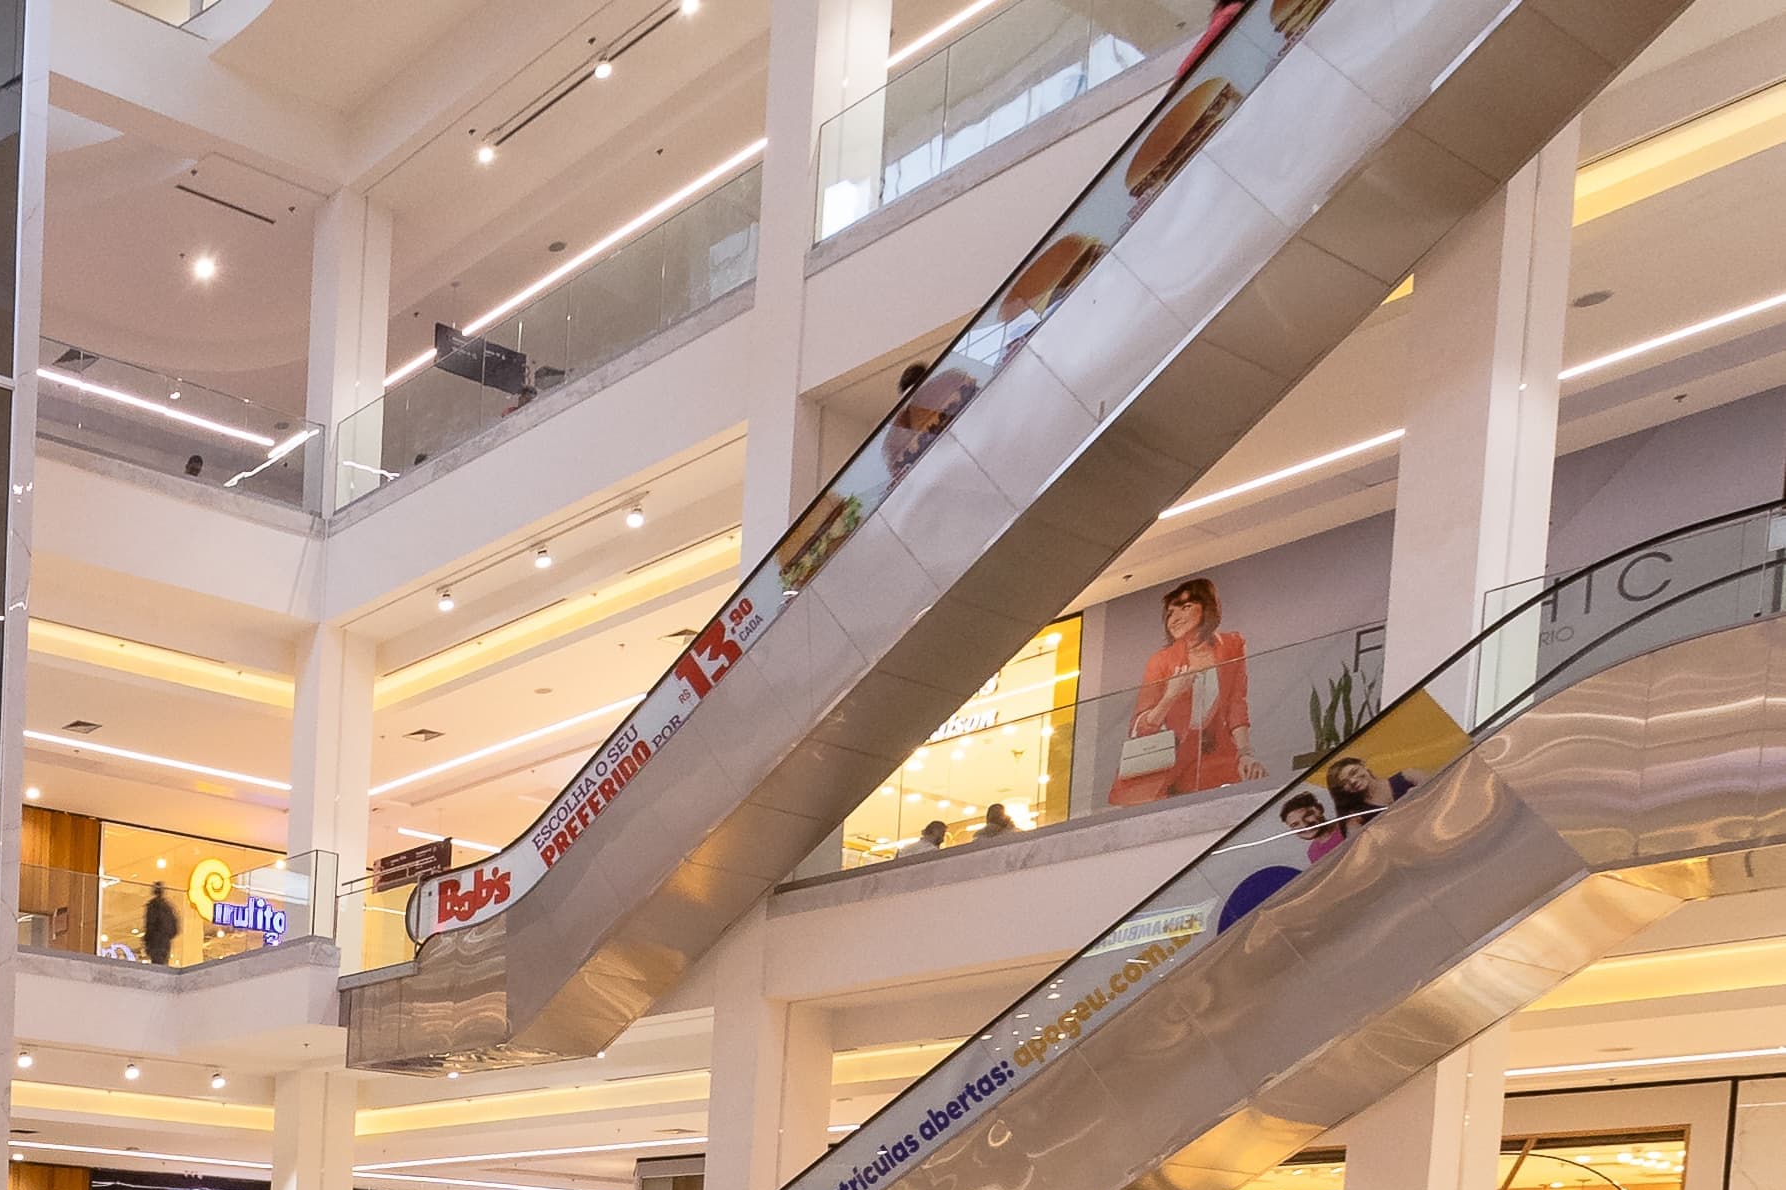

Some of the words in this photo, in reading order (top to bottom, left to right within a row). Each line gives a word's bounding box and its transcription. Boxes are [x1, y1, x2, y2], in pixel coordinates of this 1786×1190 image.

[739, 614, 764, 641] CADA
[531, 777, 597, 850] ESCOLHA
[595, 761, 608, 777] O
[607, 724, 638, 763] SEU
[540, 740, 652, 869] PREFERIDO
[651, 714, 682, 748] POR
[438, 867, 511, 924] Bob's
[919, 1060, 1015, 1141] abertas:
